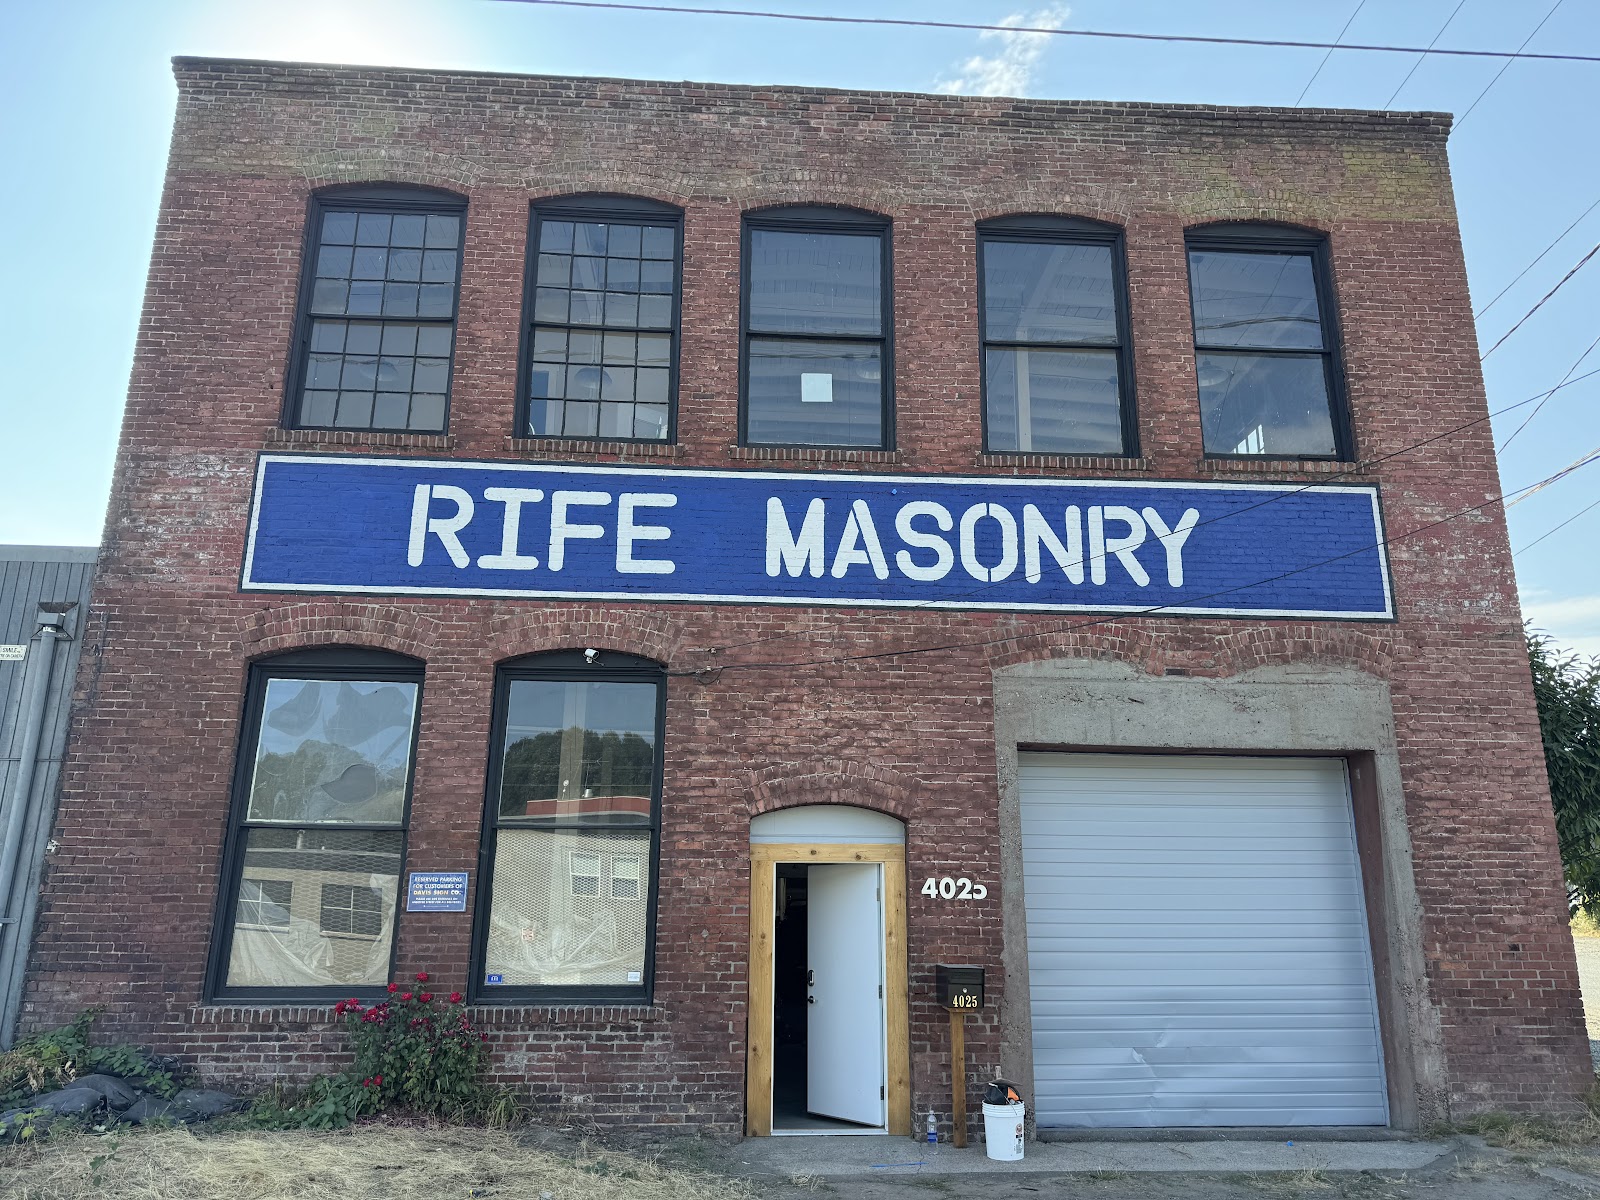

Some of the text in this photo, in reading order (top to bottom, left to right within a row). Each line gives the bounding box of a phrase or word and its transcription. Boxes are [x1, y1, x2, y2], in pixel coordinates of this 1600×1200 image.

[407, 483, 1200, 588] RIFE MASONRY
[952, 995, 978, 1008] 4025
